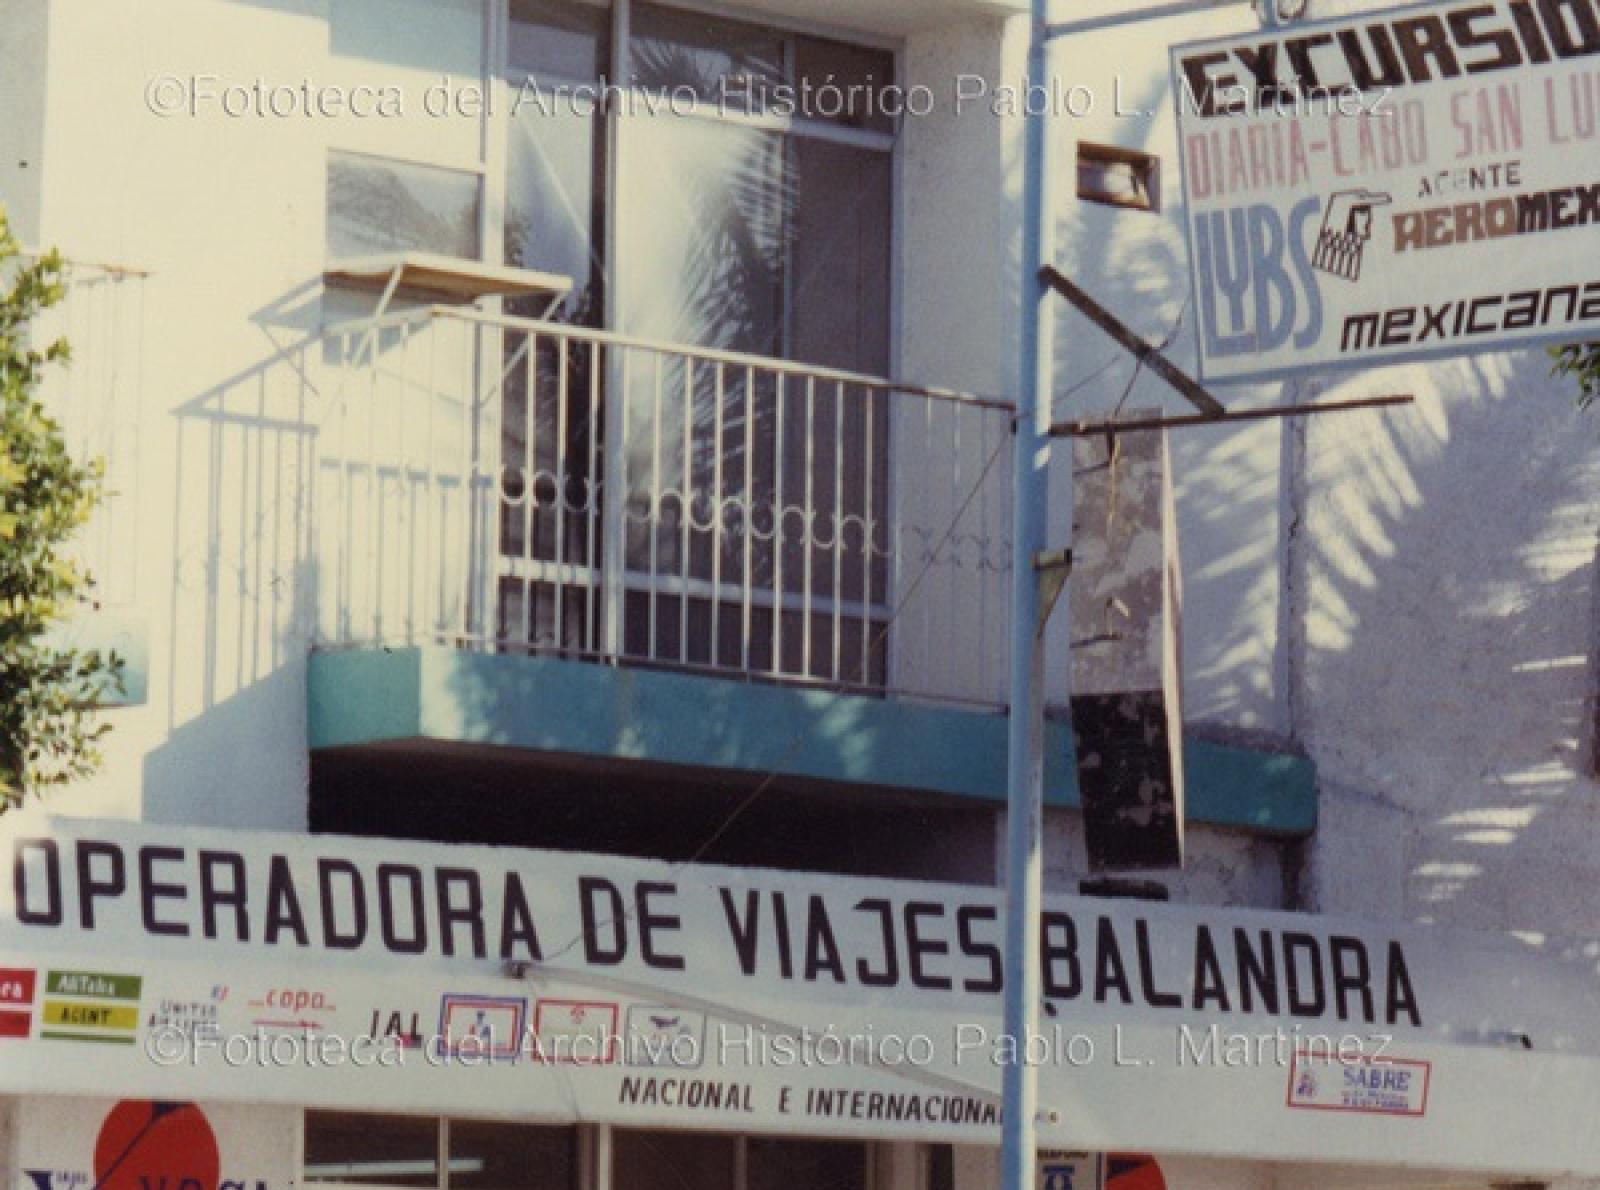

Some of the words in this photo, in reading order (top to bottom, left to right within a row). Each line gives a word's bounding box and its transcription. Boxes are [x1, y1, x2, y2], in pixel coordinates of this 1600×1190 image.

[1181, 0, 1600, 118] EXCURSIO
[1450, 83, 1523, 160] SAN
[1544, 71, 1600, 144] LU
[14, 837, 542, 962] OPERADORA
[577, 875, 686, 970] DE
[719, 886, 1003, 993] VIAJES
[1041, 911, 1423, 1028] BALANDRA
[618, 1076, 754, 1113] NACIONAL
[777, 1085, 793, 1114] E
[806, 1088, 1004, 1126] INTERNACIONA
